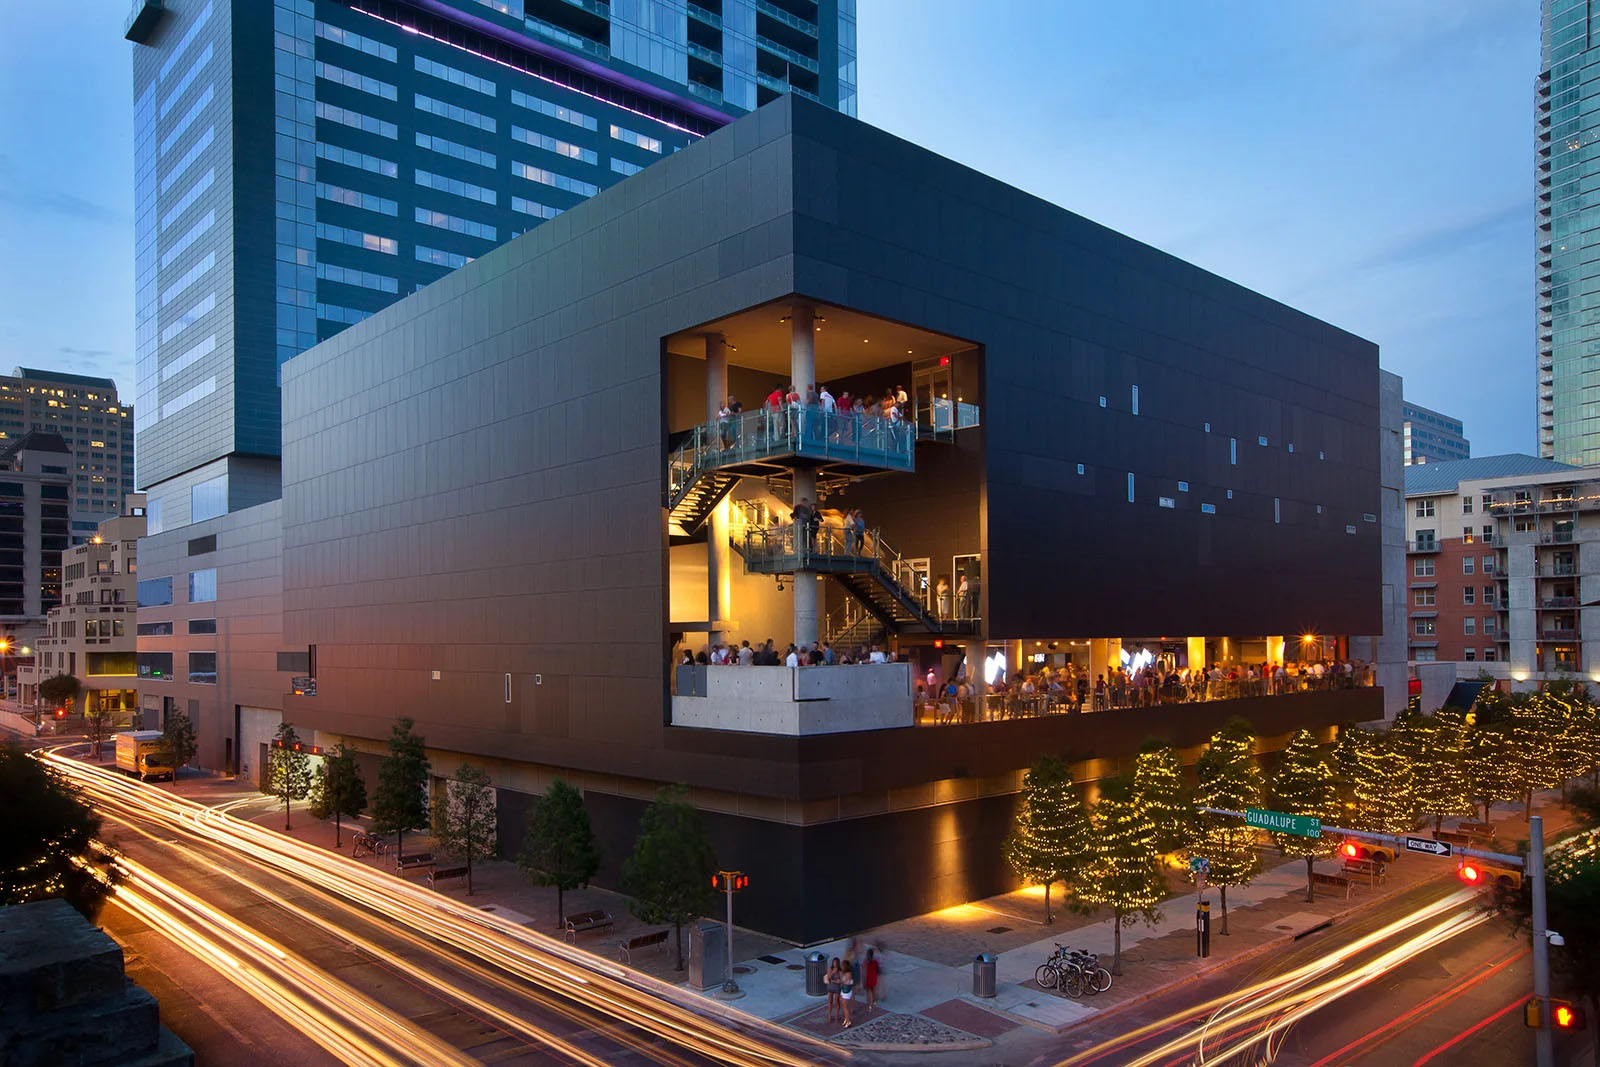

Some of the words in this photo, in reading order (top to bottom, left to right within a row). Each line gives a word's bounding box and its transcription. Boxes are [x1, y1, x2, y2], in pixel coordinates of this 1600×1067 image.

[1247, 811, 1297, 830] GUADALUPE
[1310, 818, 1320, 827] ST
[1306, 829, 1320, 838] 100
[1410, 840, 1423, 849] ONE
[1424, 842, 1437, 851] WAY
